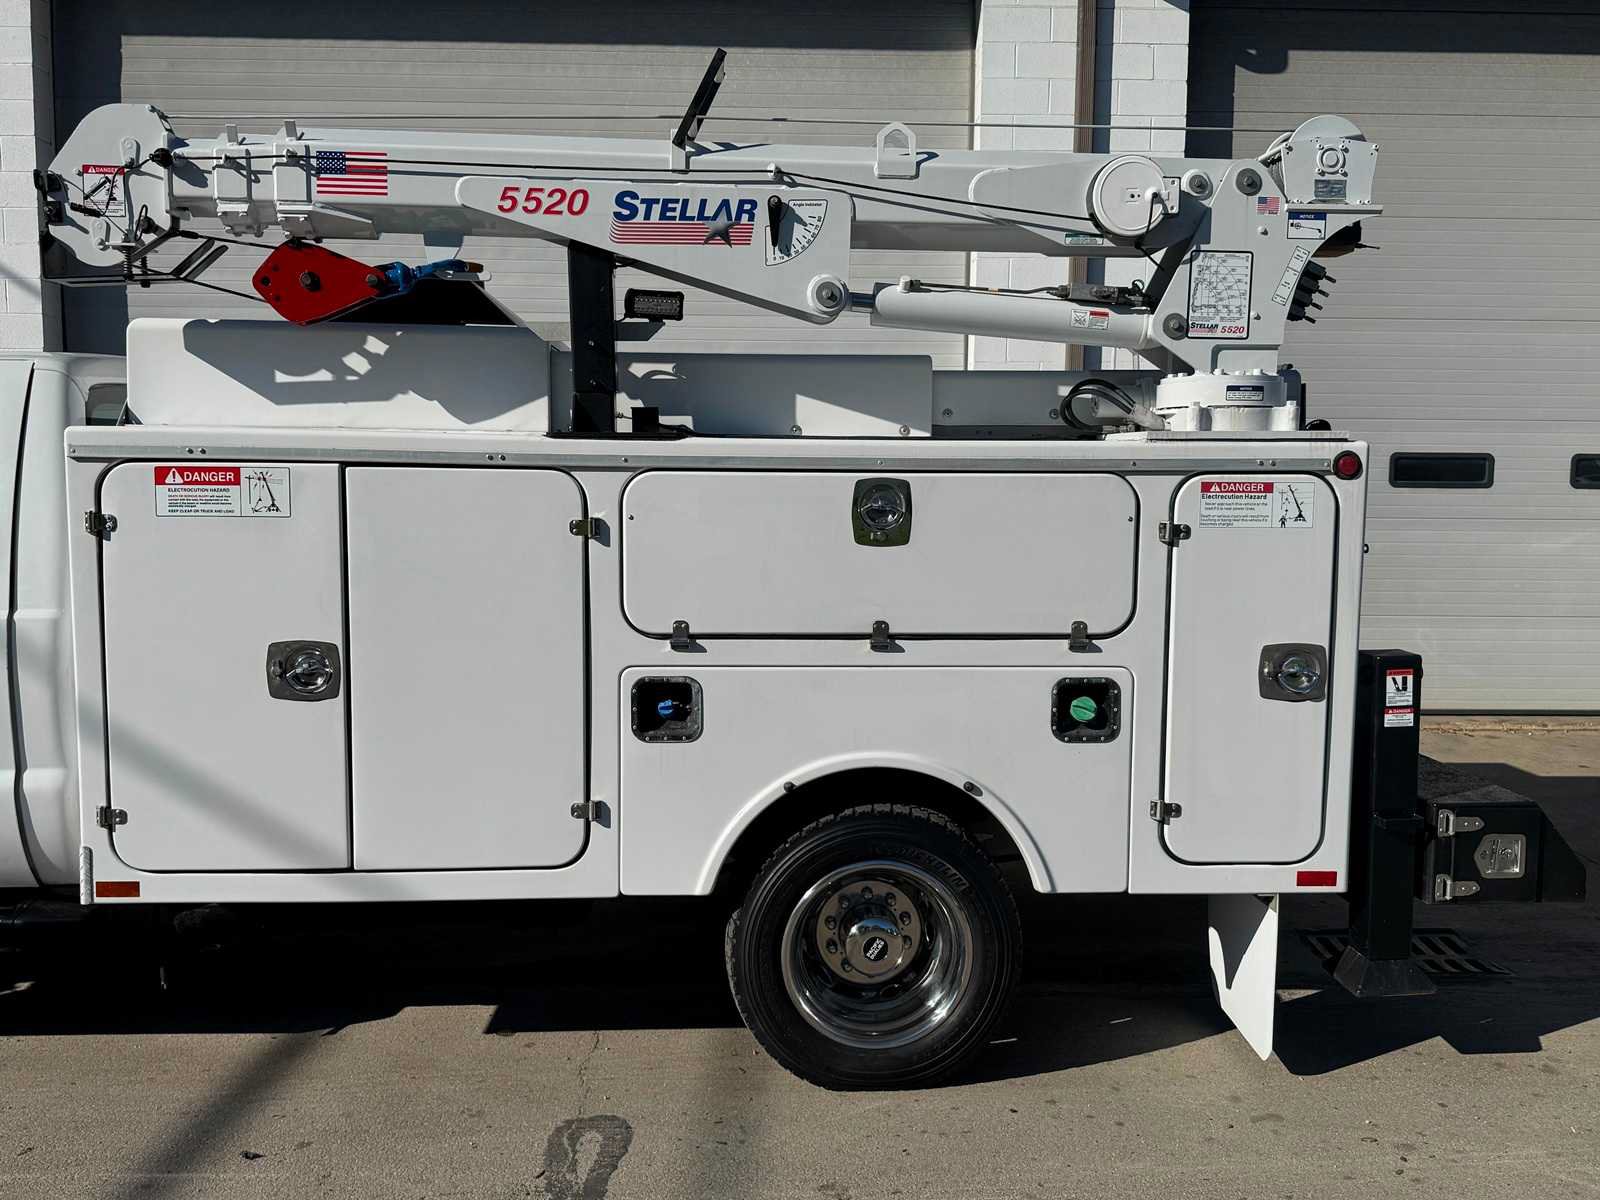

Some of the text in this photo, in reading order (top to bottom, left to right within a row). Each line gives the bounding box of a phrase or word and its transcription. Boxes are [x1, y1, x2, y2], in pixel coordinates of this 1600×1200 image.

[497, 186, 590, 216] 5520
[612, 190, 758, 223] STELLAR
[1220, 325, 1245, 334] 5520
[184, 471, 235, 482] DANGER
[1221, 483, 1264, 492] DANGER
